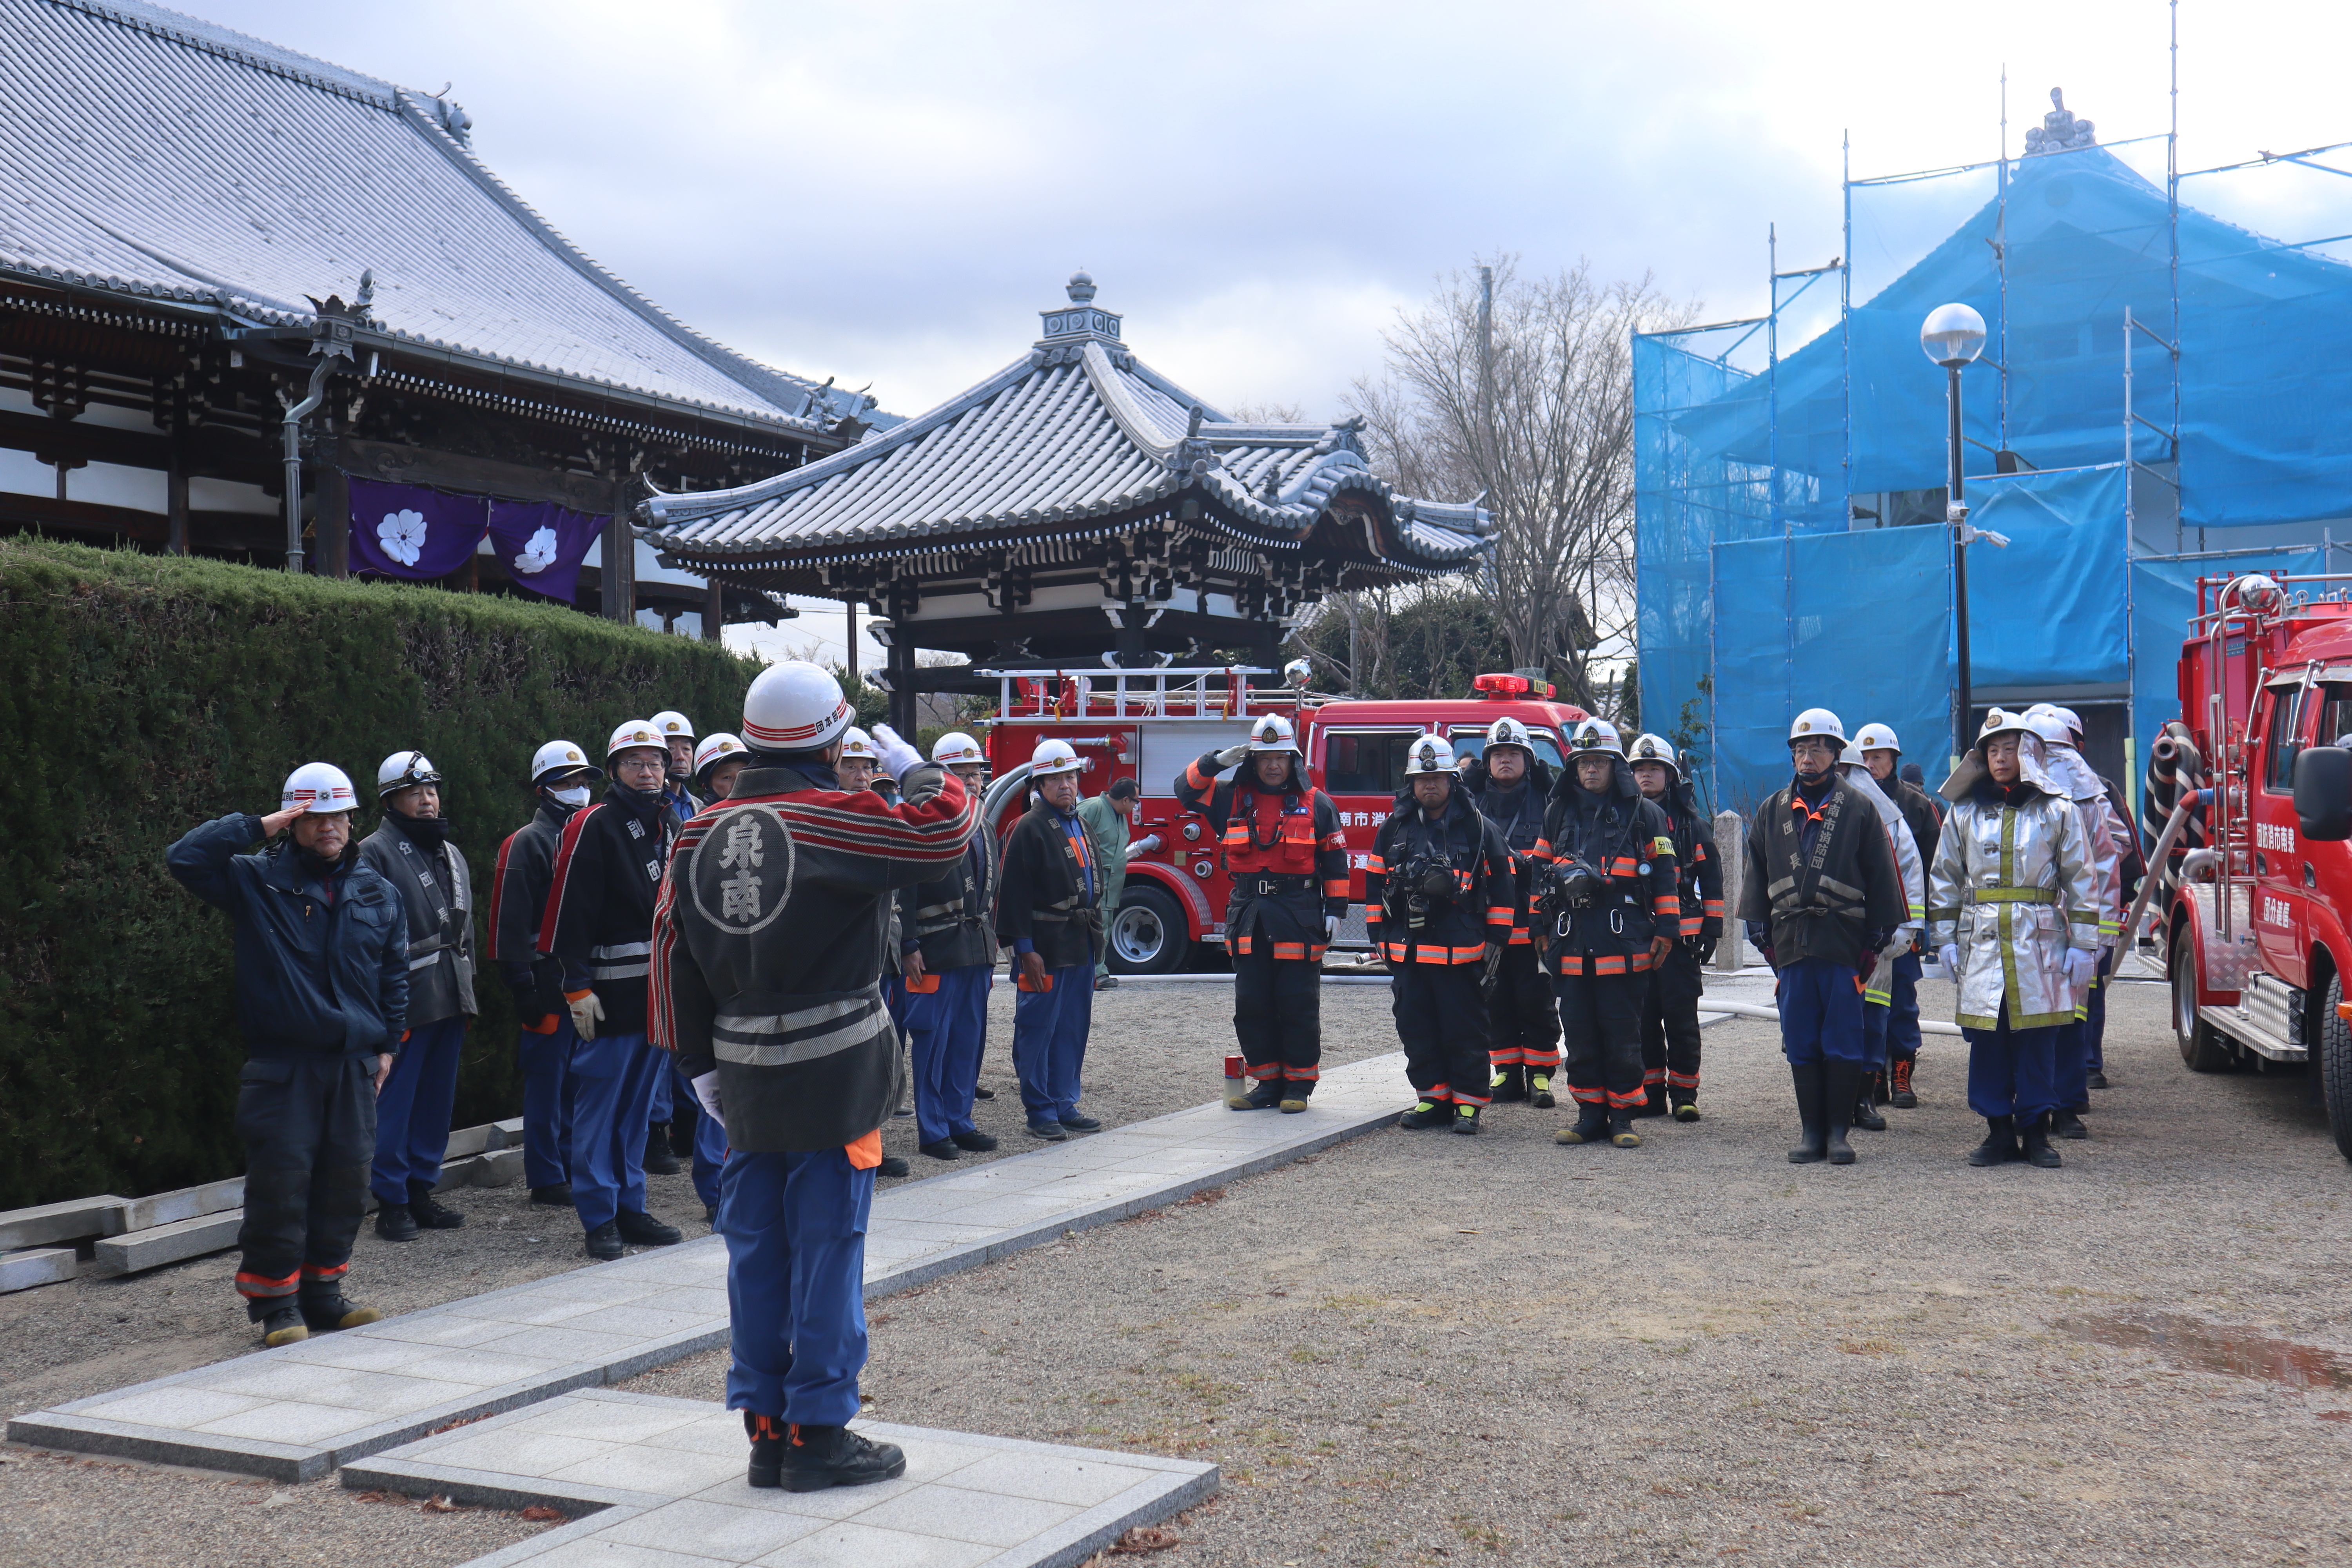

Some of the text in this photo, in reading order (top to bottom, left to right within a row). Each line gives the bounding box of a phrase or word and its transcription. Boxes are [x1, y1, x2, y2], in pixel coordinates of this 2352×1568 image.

[815, 710, 838, 733] 団本部
[1339, 811, 1394, 827] 南市消
[1810, 791, 1845, 870] 泉南市消防団
[719, 814, 765, 923] 泉南
[1048, 818, 1087, 893] 副団長
[965, 876, 975, 893] 長
